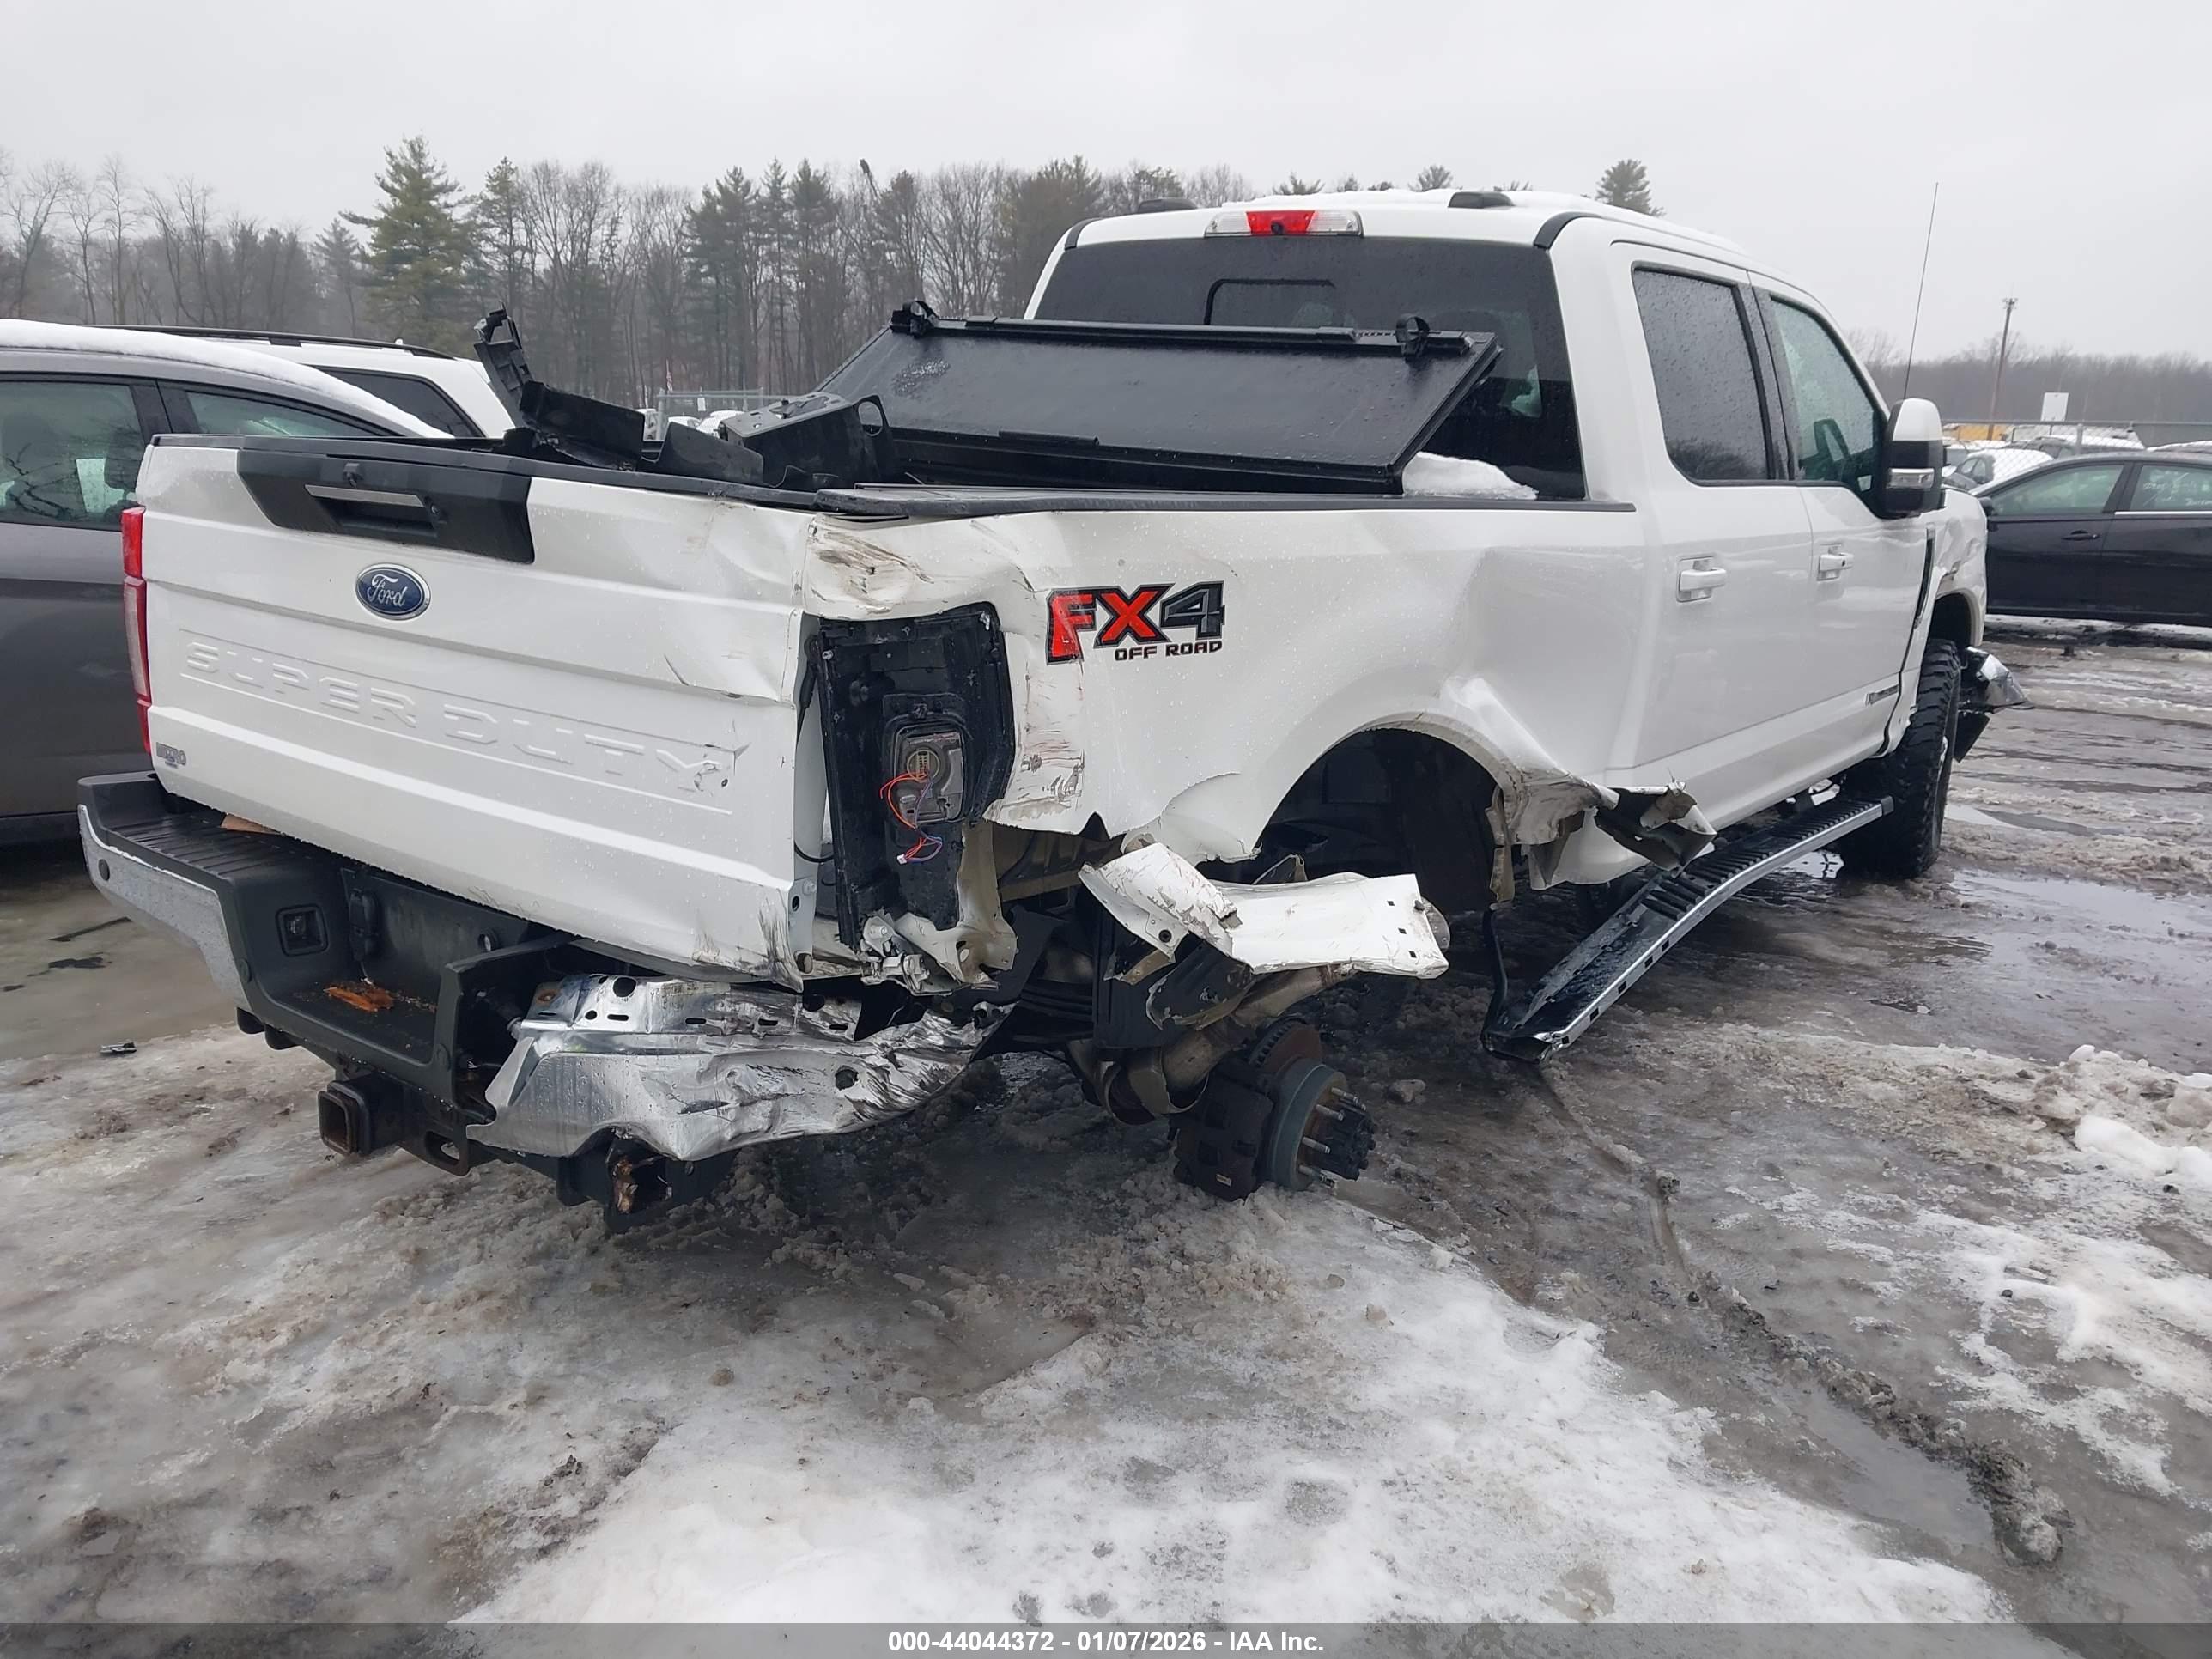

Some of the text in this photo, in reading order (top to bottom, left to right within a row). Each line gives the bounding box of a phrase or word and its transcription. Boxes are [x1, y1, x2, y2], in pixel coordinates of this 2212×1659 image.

[366, 574, 409, 607] Ford
[1046, 580, 1225, 665] FX4
[1115, 641, 1223, 661] OFF ROAD
[185, 641, 723, 794] SUPER DUTY
